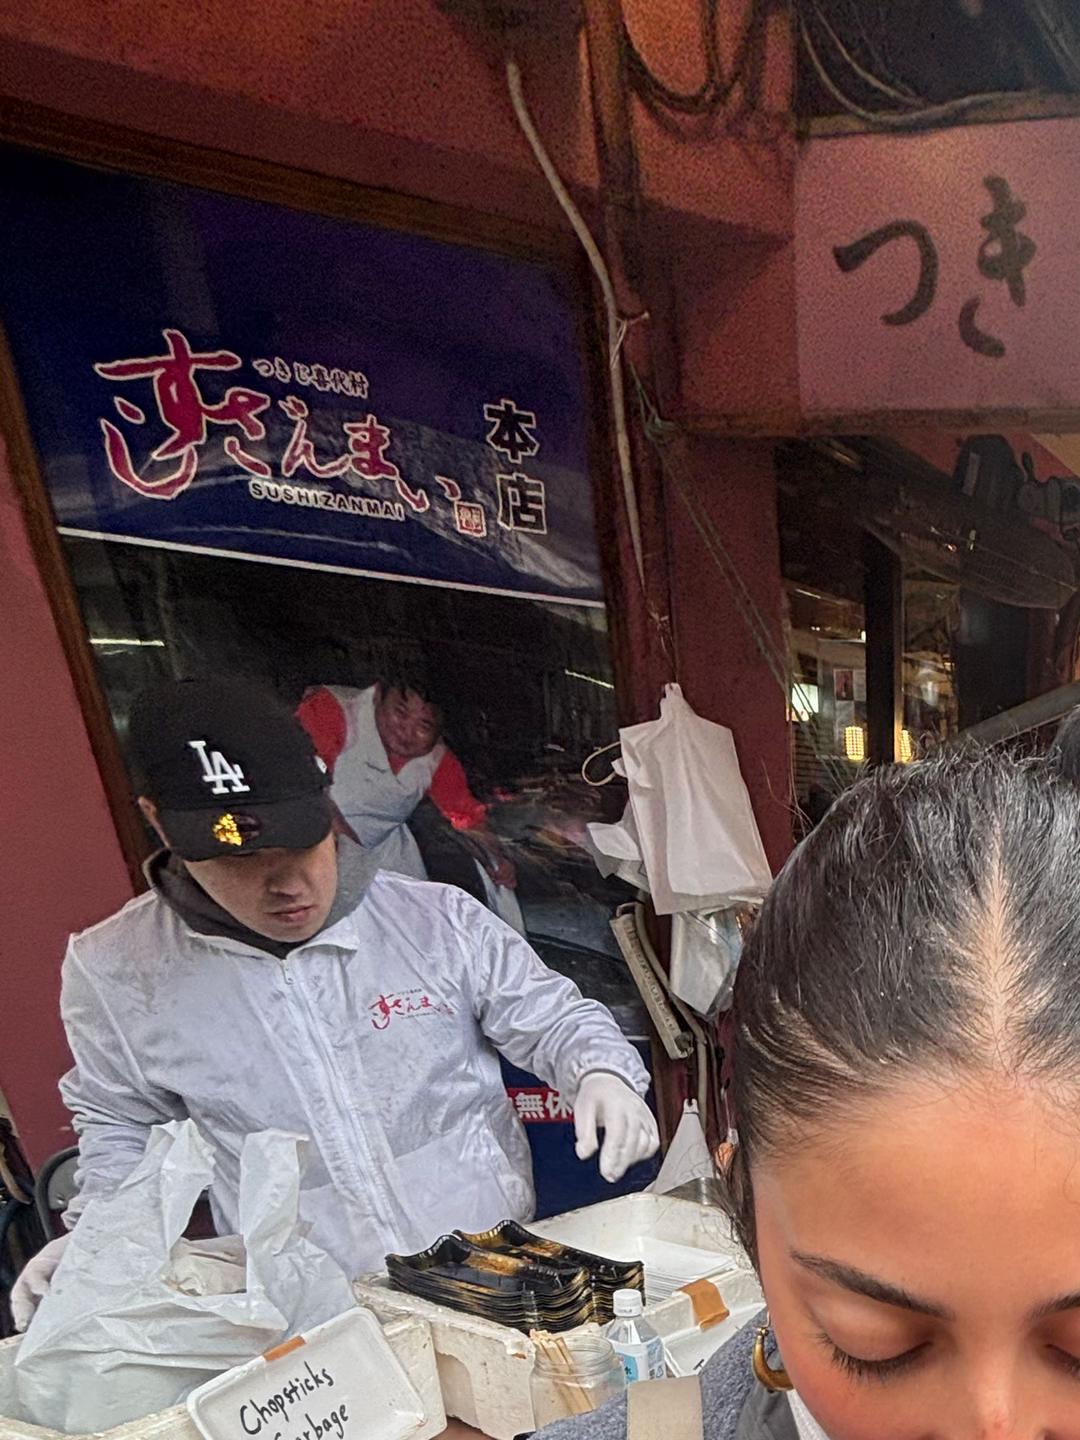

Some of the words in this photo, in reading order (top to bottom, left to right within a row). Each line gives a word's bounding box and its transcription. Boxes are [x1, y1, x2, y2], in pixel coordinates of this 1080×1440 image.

[484, 399, 548, 536] 本店
[249, 477, 405, 521] SUSHIZANMAI
[187, 740, 250, 794] LA
[508, 1092, 573, 1119] 無休
[240, 1361, 334, 1435] Chopsticks
